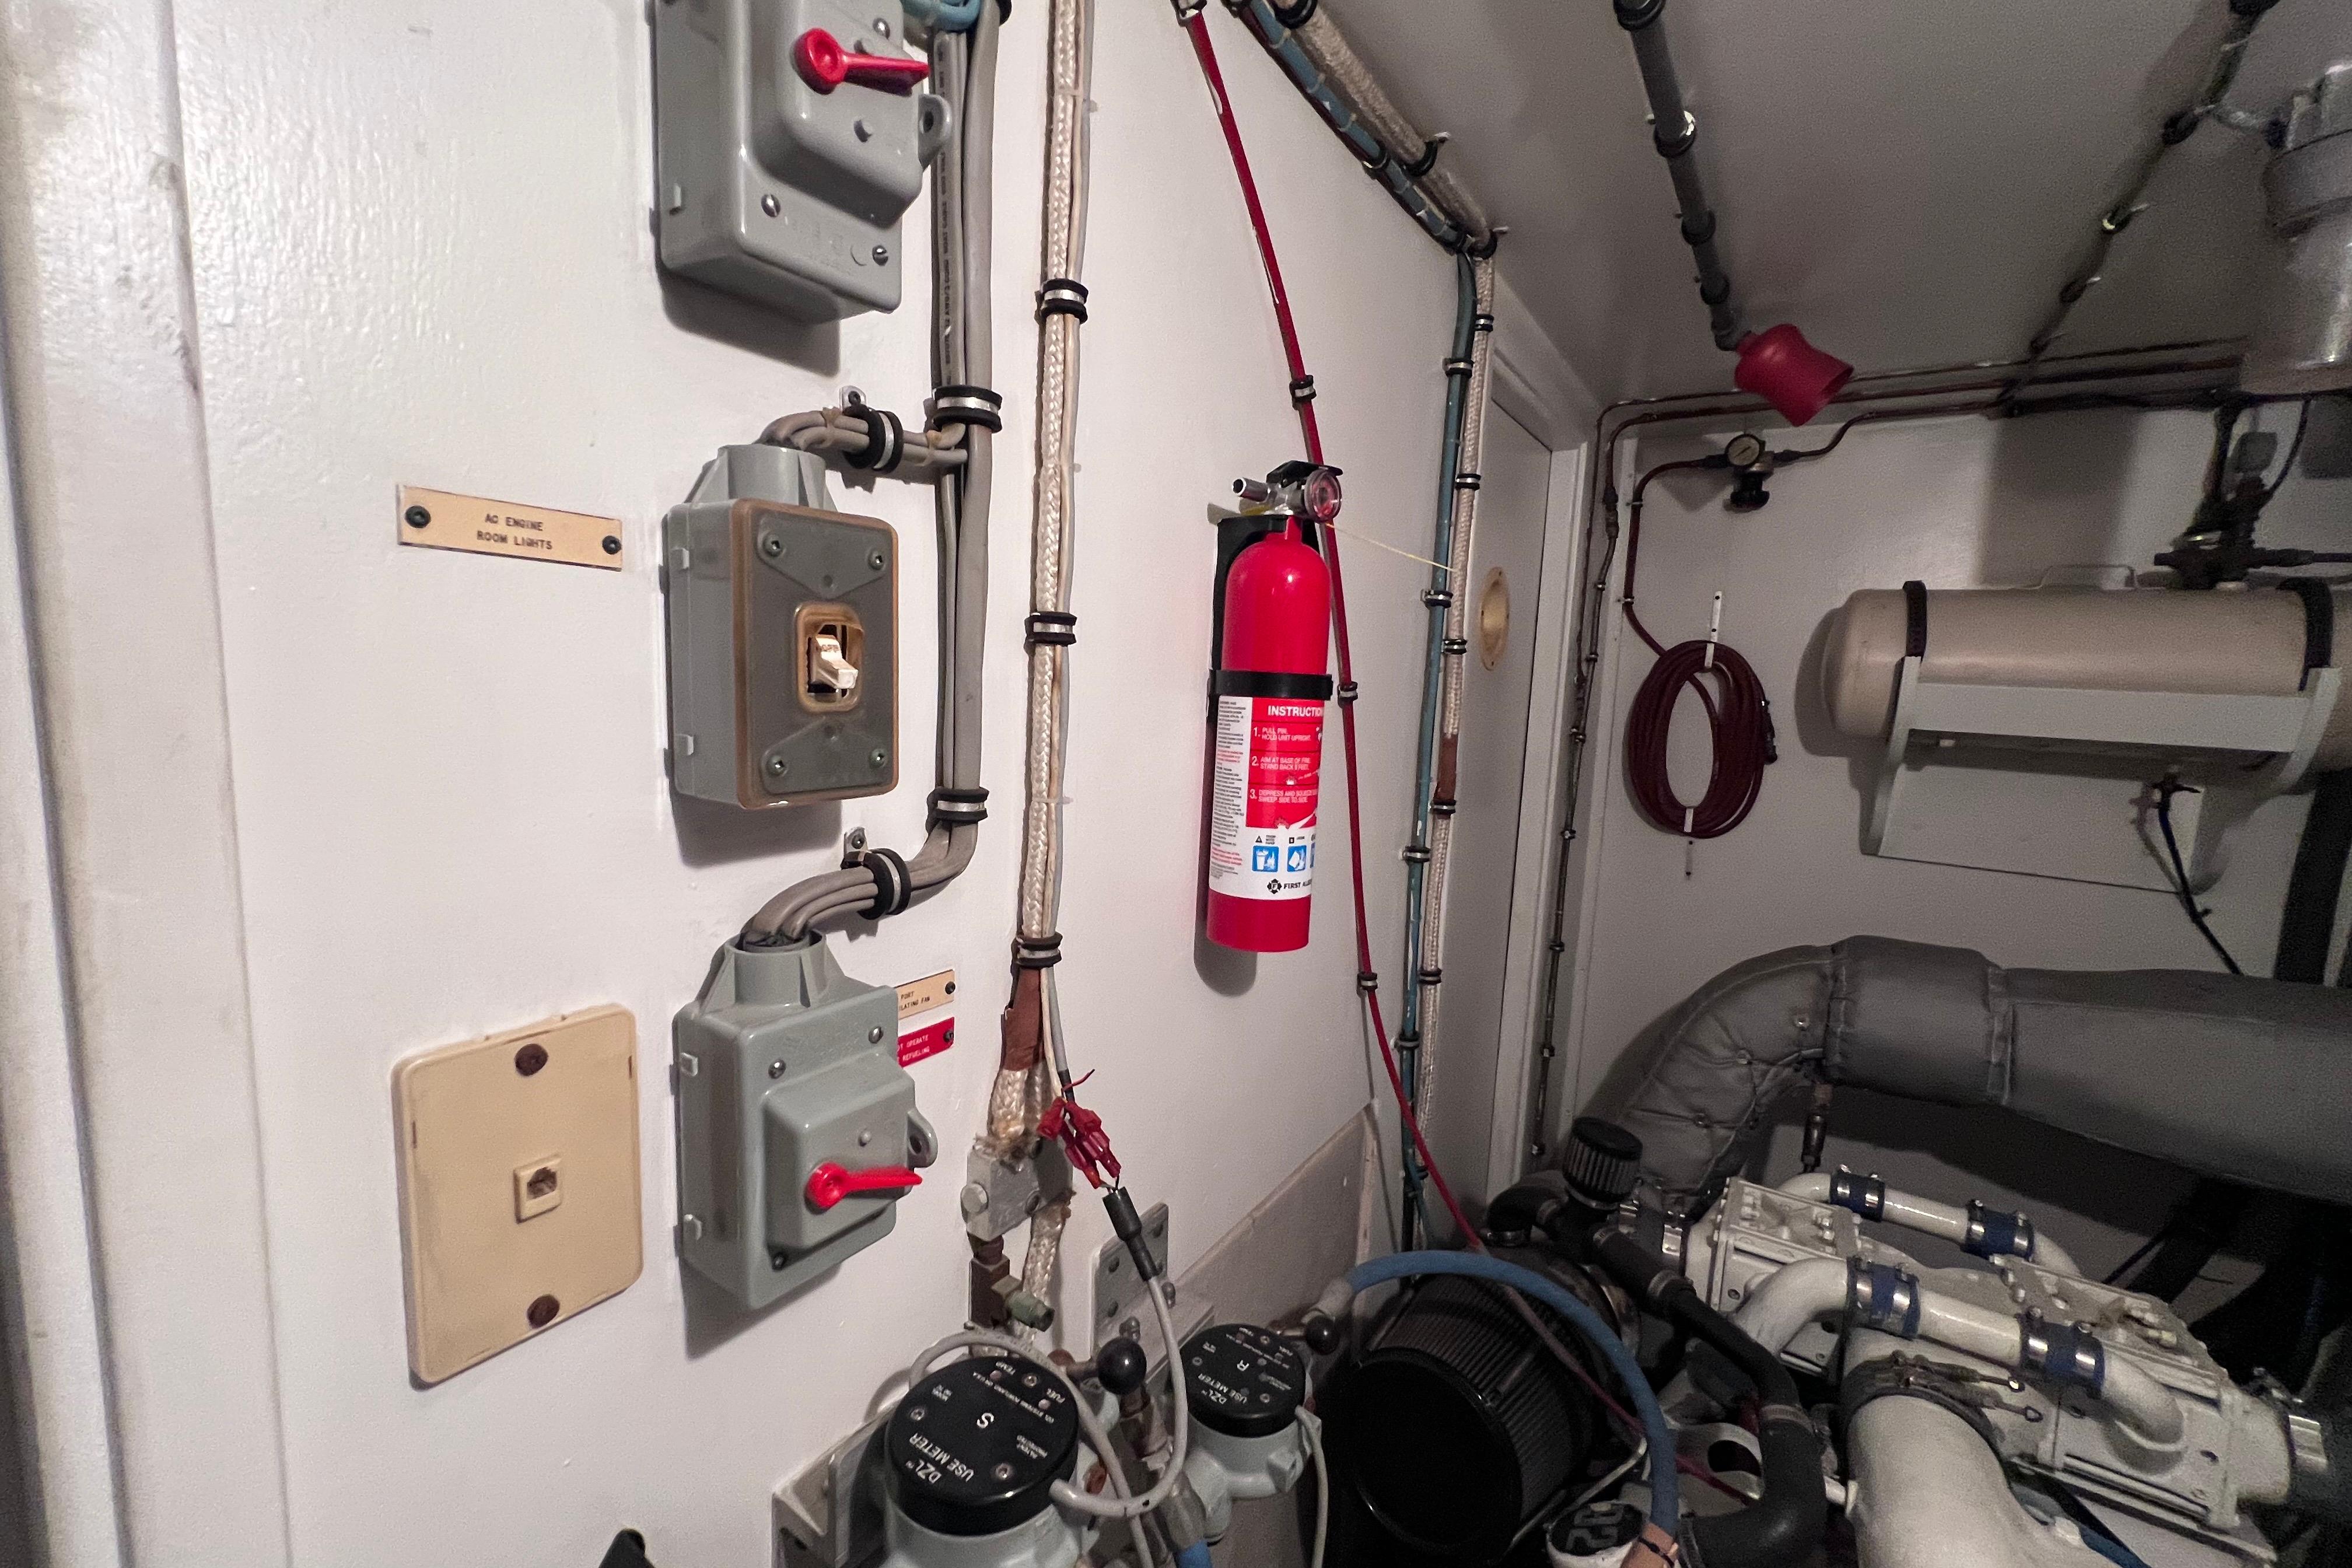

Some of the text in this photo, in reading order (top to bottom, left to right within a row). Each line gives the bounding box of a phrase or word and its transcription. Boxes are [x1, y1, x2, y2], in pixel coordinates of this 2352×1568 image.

[485, 513, 543, 531] AC ENGINE
[477, 530, 552, 550] ROOM LIGHTS
[901, 991, 914, 999] PORT
[907, 1034, 929, 1048] OPERATE
[902, 1046, 930, 1061] REFUELING
[996, 1361, 1016, 1375] TEMP
[1237, 1360, 1249, 1371] R
[1046, 1388, 1065, 1404] FUEL
[1198, 1373, 1247, 1404] USE METER
[977, 1412, 994, 1429] S
[909, 1433, 974, 1482] USE METER
